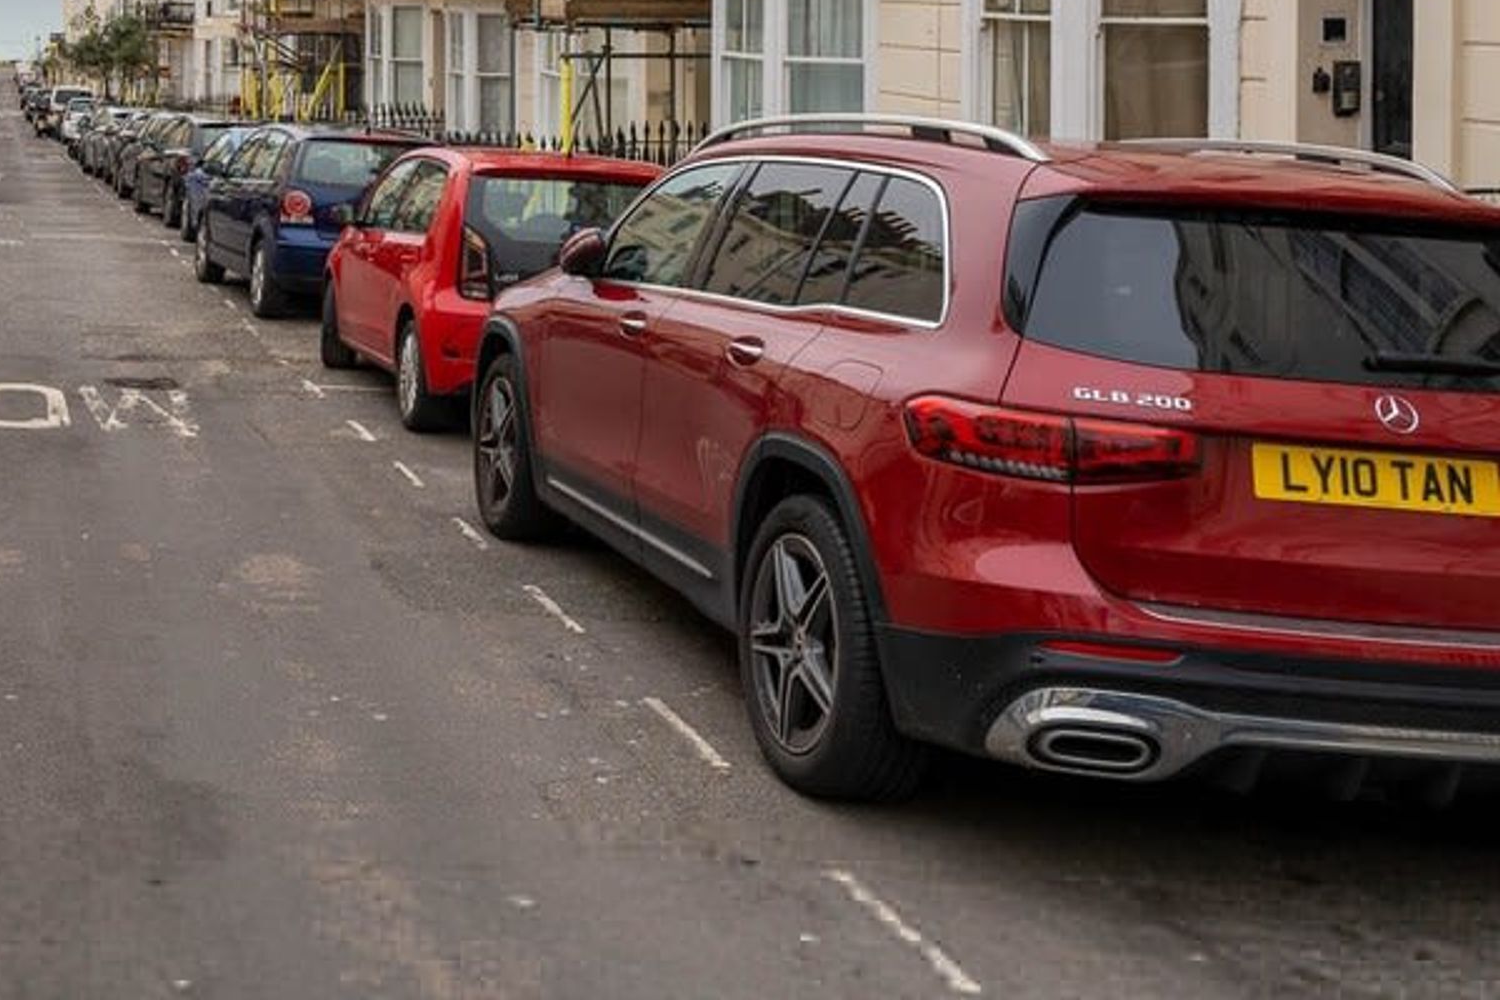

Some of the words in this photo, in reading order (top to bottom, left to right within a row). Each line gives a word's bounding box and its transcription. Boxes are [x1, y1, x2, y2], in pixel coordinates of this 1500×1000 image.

[1073, 386, 1130, 404] GLB
[1135, 393, 1192, 411] 200
[1281, 452, 1378, 498] LY10
[1390, 460, 1474, 505] TAN
